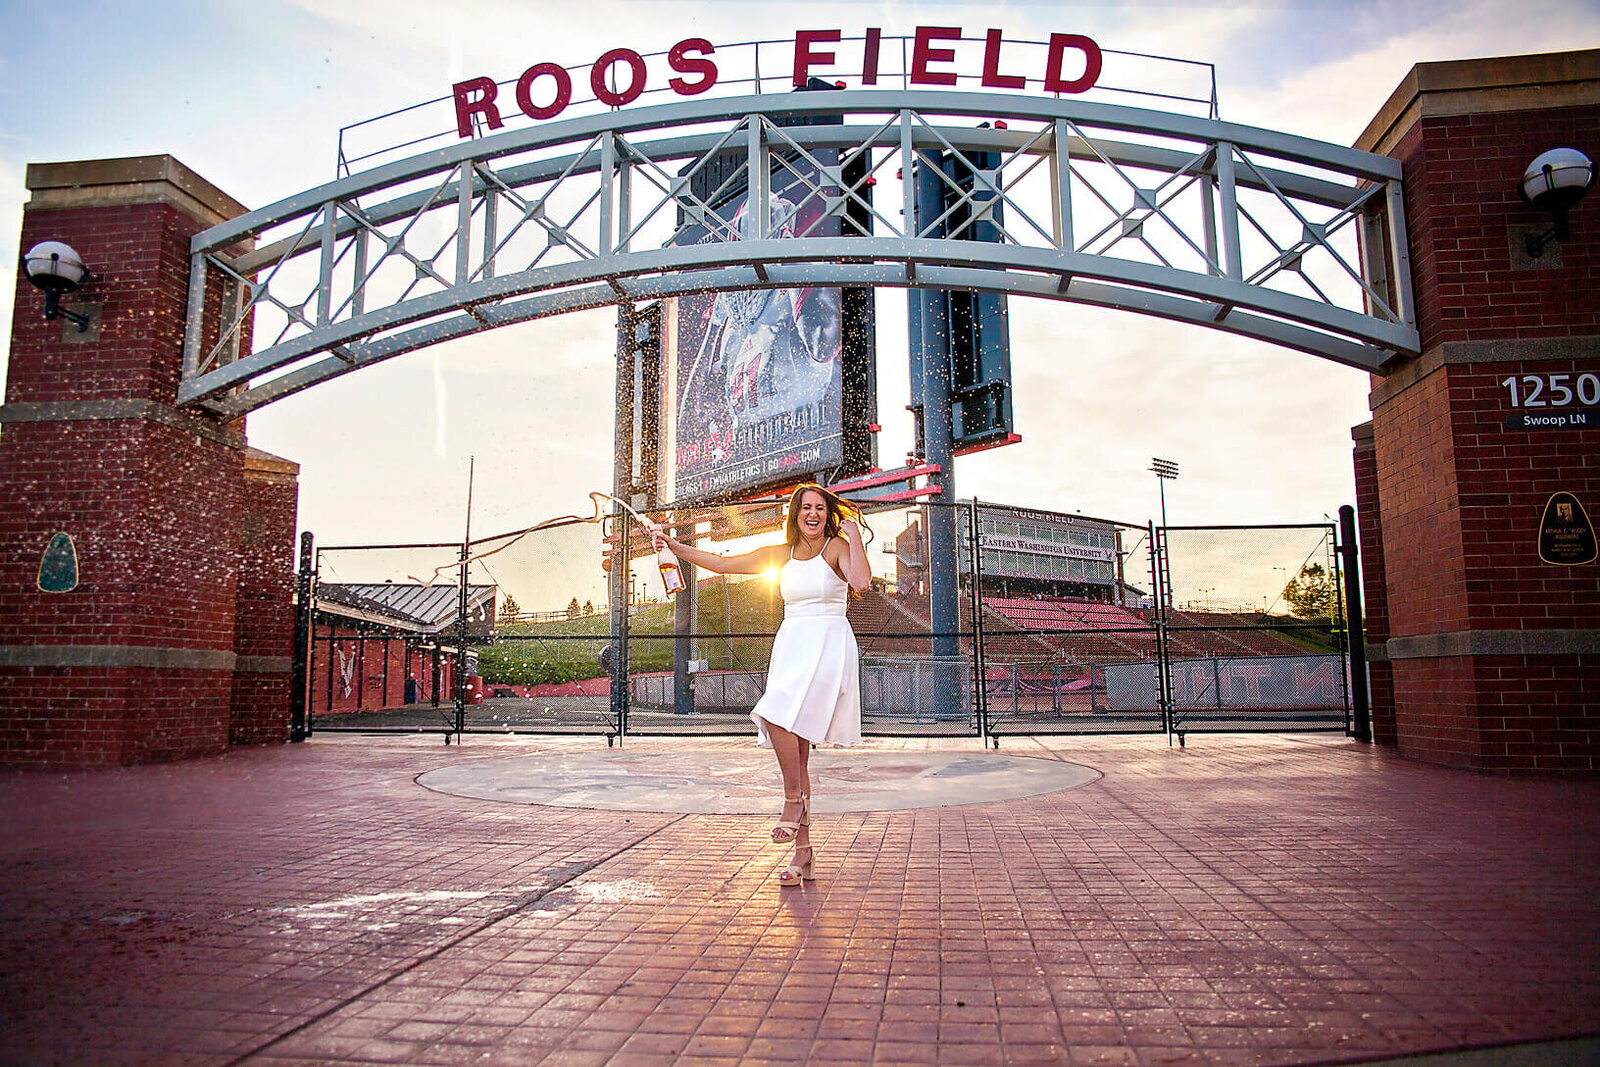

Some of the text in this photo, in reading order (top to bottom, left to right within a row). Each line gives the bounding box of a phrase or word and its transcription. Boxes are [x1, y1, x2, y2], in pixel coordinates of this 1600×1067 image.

[452, 26, 1102, 138] ROOS FIELD
[1502, 373, 1600, 407] 1250
[1523, 414, 1586, 427] Swoop LN
[768, 449, 821, 471] GOEAGS.COM
[983, 536, 1102, 558] EASTERN WASHINGTON UNIVERSITY
